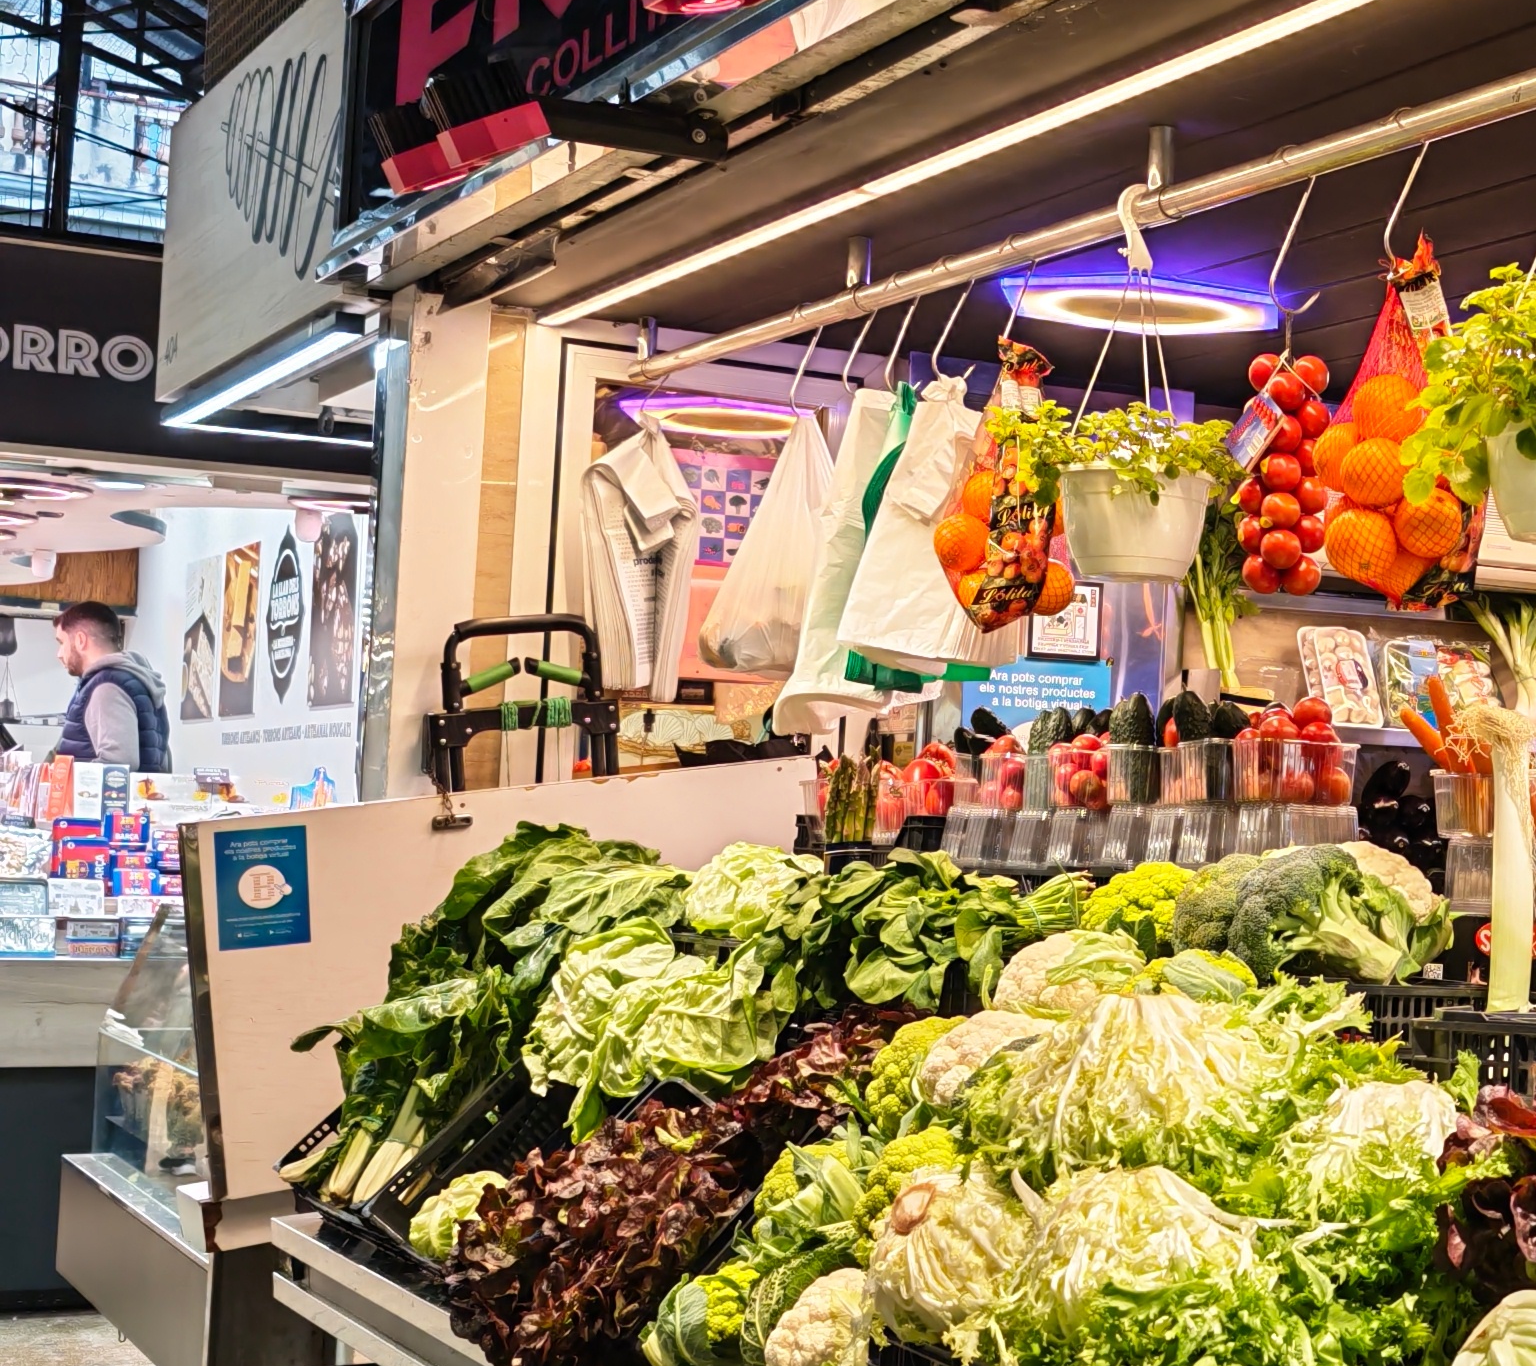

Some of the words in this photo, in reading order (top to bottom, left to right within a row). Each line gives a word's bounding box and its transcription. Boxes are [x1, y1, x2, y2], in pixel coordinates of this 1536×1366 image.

[0, 323, 154, 382] RRO
[989, 669, 1008, 681] Ara
[1011, 672, 1036, 684] pots
[1038, 673, 1083, 686] comprar
[979, 683, 995, 694] els
[998, 685, 1038, 696] nostres
[1041, 687, 1096, 700] productes
[991, 698, 999, 706] a
[1002, 696, 1012, 707] la
[1014, 697, 1048, 710] botiga
[1051, 700, 1083, 711] virtual
[94, 853, 105, 879] ARÇA
